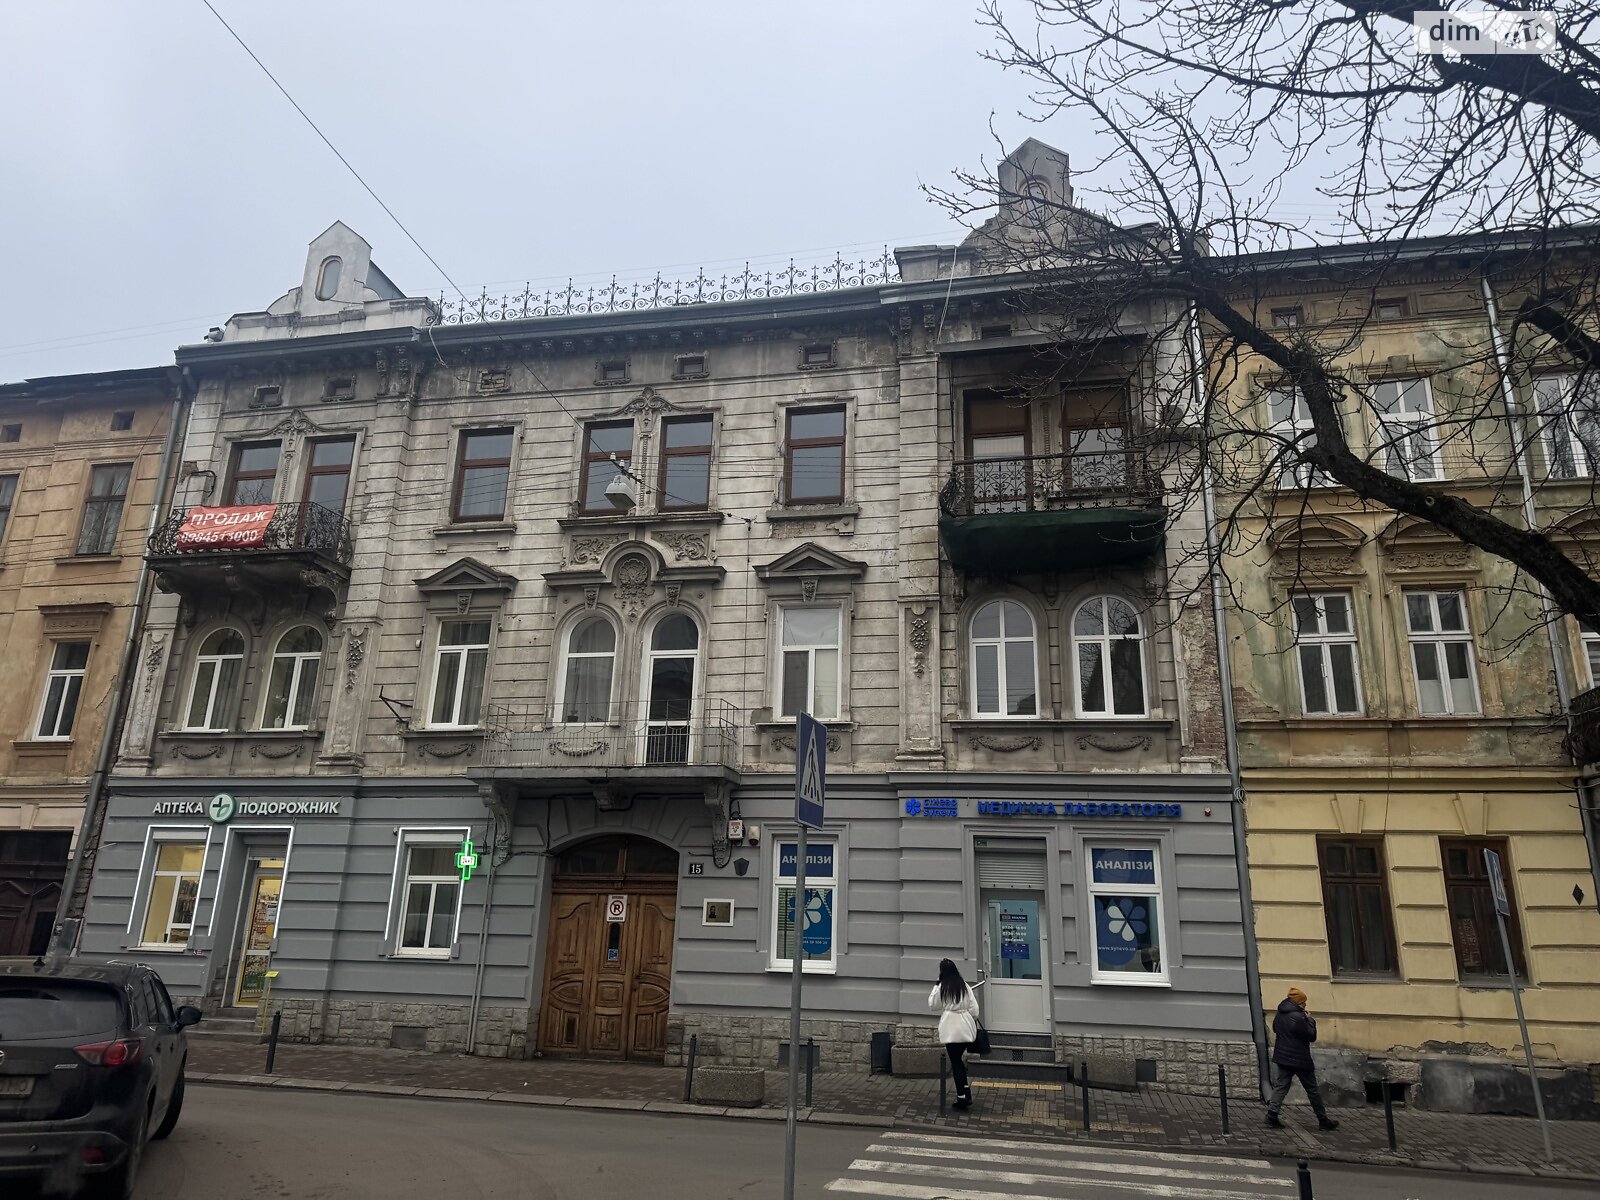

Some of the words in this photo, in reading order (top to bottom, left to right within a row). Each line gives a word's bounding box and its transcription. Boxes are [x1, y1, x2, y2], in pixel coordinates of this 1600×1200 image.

[191, 511, 269, 525] ПРОДАЖ
[152, 801, 204, 814] АПТЕКА
[238, 801, 340, 815] ПОДОРОЖНИК
[977, 800, 1057, 816] МЕДИЧНА
[1063, 802, 1182, 817] ЛАБОРАТОРІЯ
[781, 855, 832, 865] АНЛІЗИ
[1095, 860, 1153, 871] АНАЛІЗИ
[690, 863, 702, 874] 15
